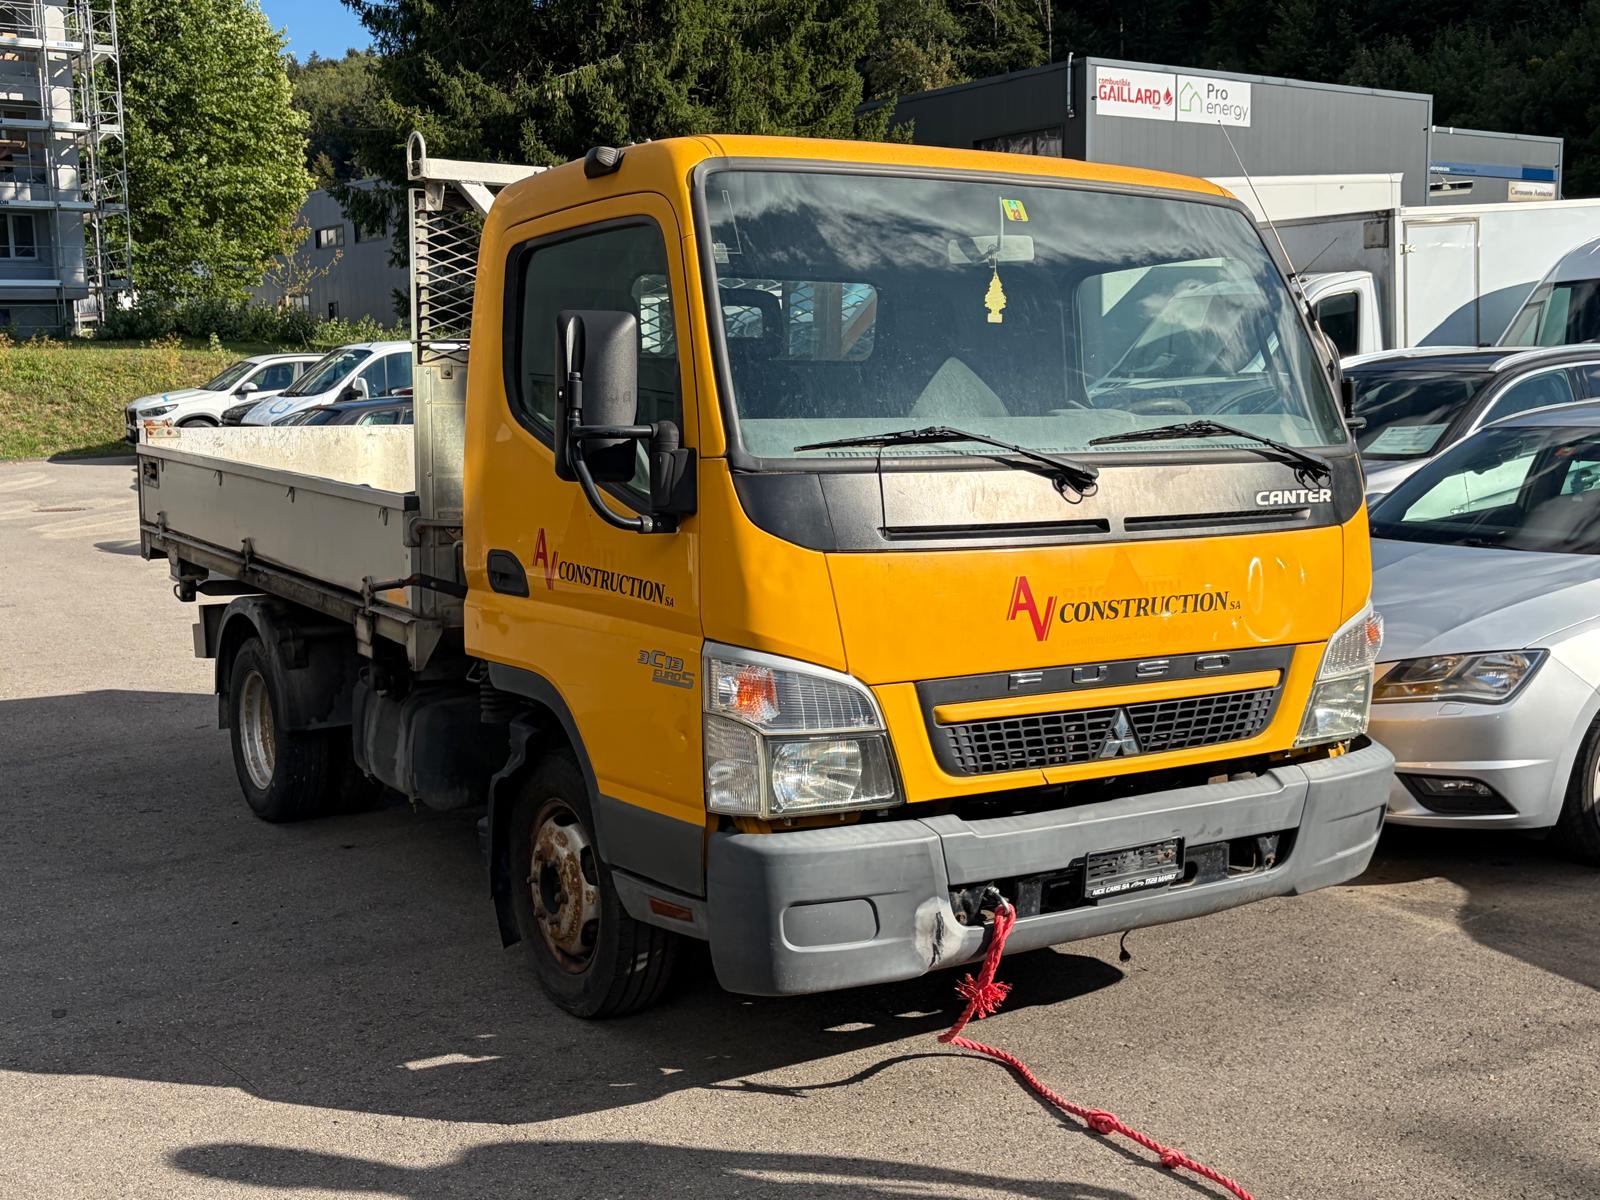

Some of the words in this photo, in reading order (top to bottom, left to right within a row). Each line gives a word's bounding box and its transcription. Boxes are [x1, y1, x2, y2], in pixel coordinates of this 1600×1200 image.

[1098, 85, 1162, 106] GAILLARD
[1207, 83, 1229, 101] Pro
[1206, 103, 1250, 121] energy
[1256, 488, 1332, 506] CANTER
[559, 560, 665, 605] CONSTRUCTION
[1059, 591, 1230, 624] CONSTRUCTION
[1008, 655, 1231, 690] FUSO
